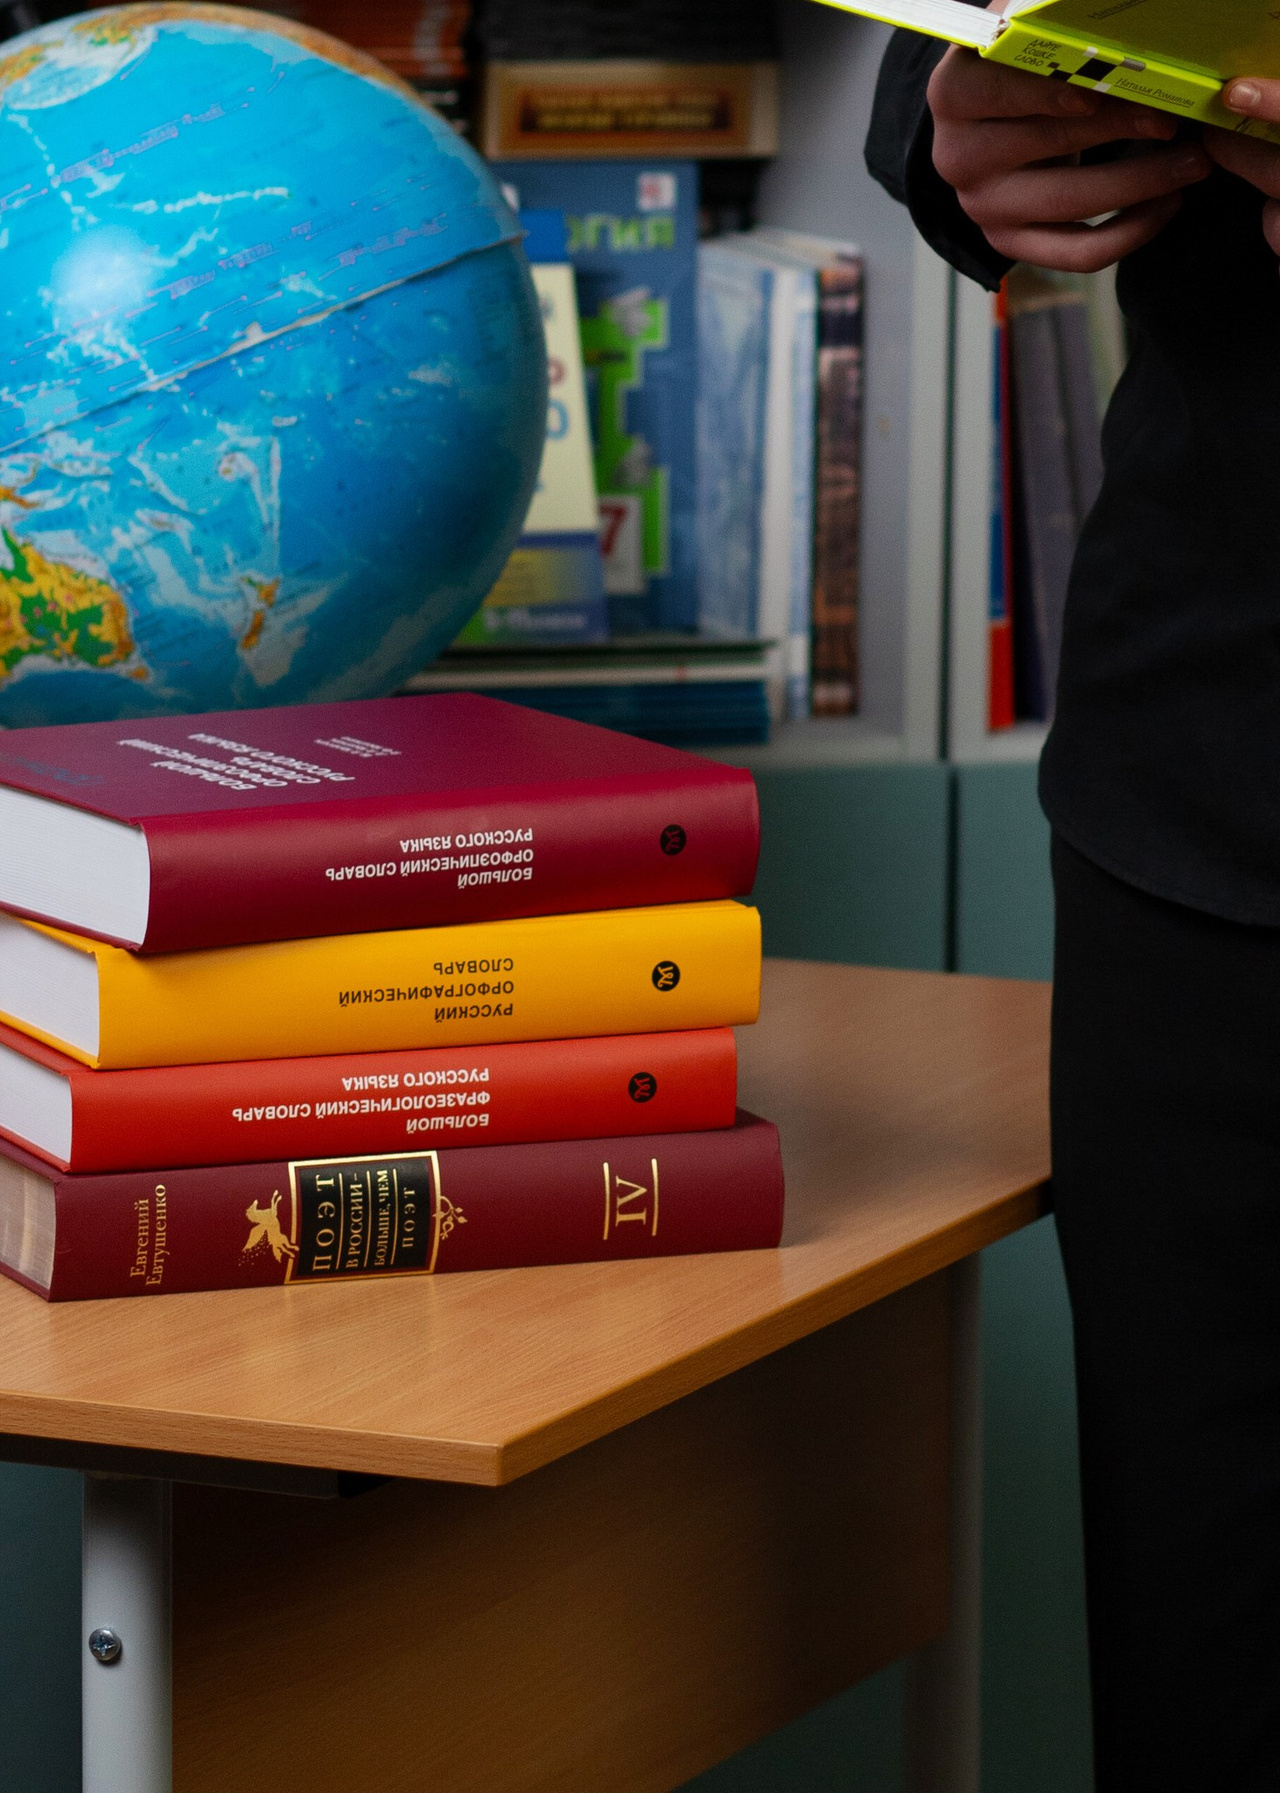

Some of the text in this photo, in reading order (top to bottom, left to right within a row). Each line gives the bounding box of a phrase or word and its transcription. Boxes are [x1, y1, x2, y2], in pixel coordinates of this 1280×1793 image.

[1023, 47, 1055, 61] КОШКЕ
[1028, 39, 1061, 53] ДАЙТЕ
[1014, 55, 1044, 68] СЛОВО
[399, 828, 533, 853] РУССКОГО ЯЗЫКА
[325, 849, 534, 882] ОРФОЭПИЧЕСКИЙ СЛОВАРЬ
[457, 867, 533, 890] БОЛЬШОЙ
[433, 957, 515, 976] СЛОВАРЬ
[338, 981, 515, 1006] ОРФОГРАФИЧЕСКИЙ
[434, 1003, 514, 1023] РУССКИЙ
[341, 1067, 490, 1092] РУССКОГО ЯЗЫКА
[232, 1091, 491, 1122] ФРАЗЕОЛОГИЧЕСКИЙ СЛОВАРЬ
[406, 1113, 490, 1134] БОЛЬШОЙ
[615, 1176, 649, 1227] IV
[312, 1174, 336, 1272] ПОЭТ
[374, 1169, 391, 1266] БОЛЬШЕ, ЧЕМ
[401, 1187, 416, 1248] ПОЭТ
[129, 1198, 151, 1278] Евгений
[145, 1184, 169, 1286] Евтушенко
[345, 1258, 359, 1269] В
